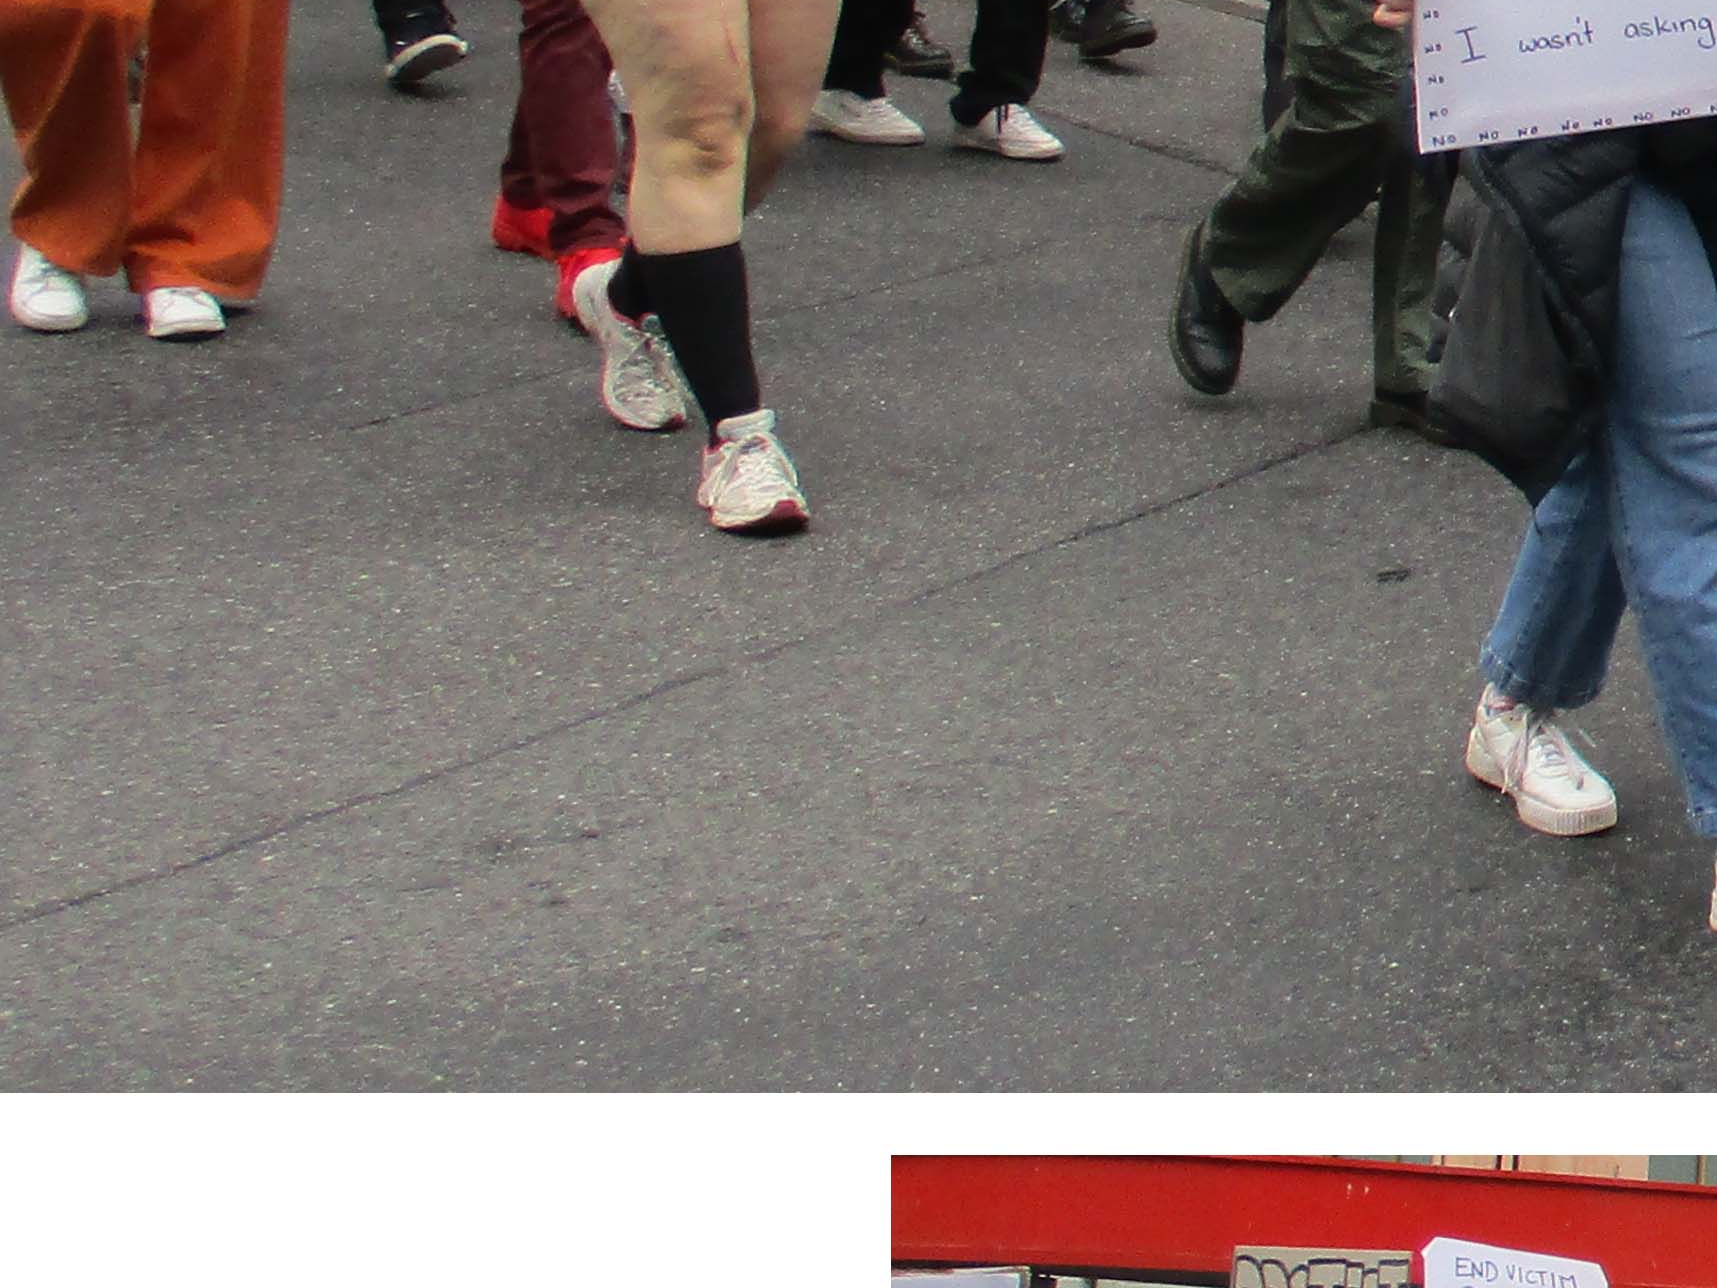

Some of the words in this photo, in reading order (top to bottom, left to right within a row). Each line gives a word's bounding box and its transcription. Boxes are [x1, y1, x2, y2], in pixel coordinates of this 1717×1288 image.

[1454, 25, 1487, 64] I
[1518, 16, 1595, 54] wasn't
[1623, 15, 1716, 49] asking
[1454, 1257, 1498, 1284] END
